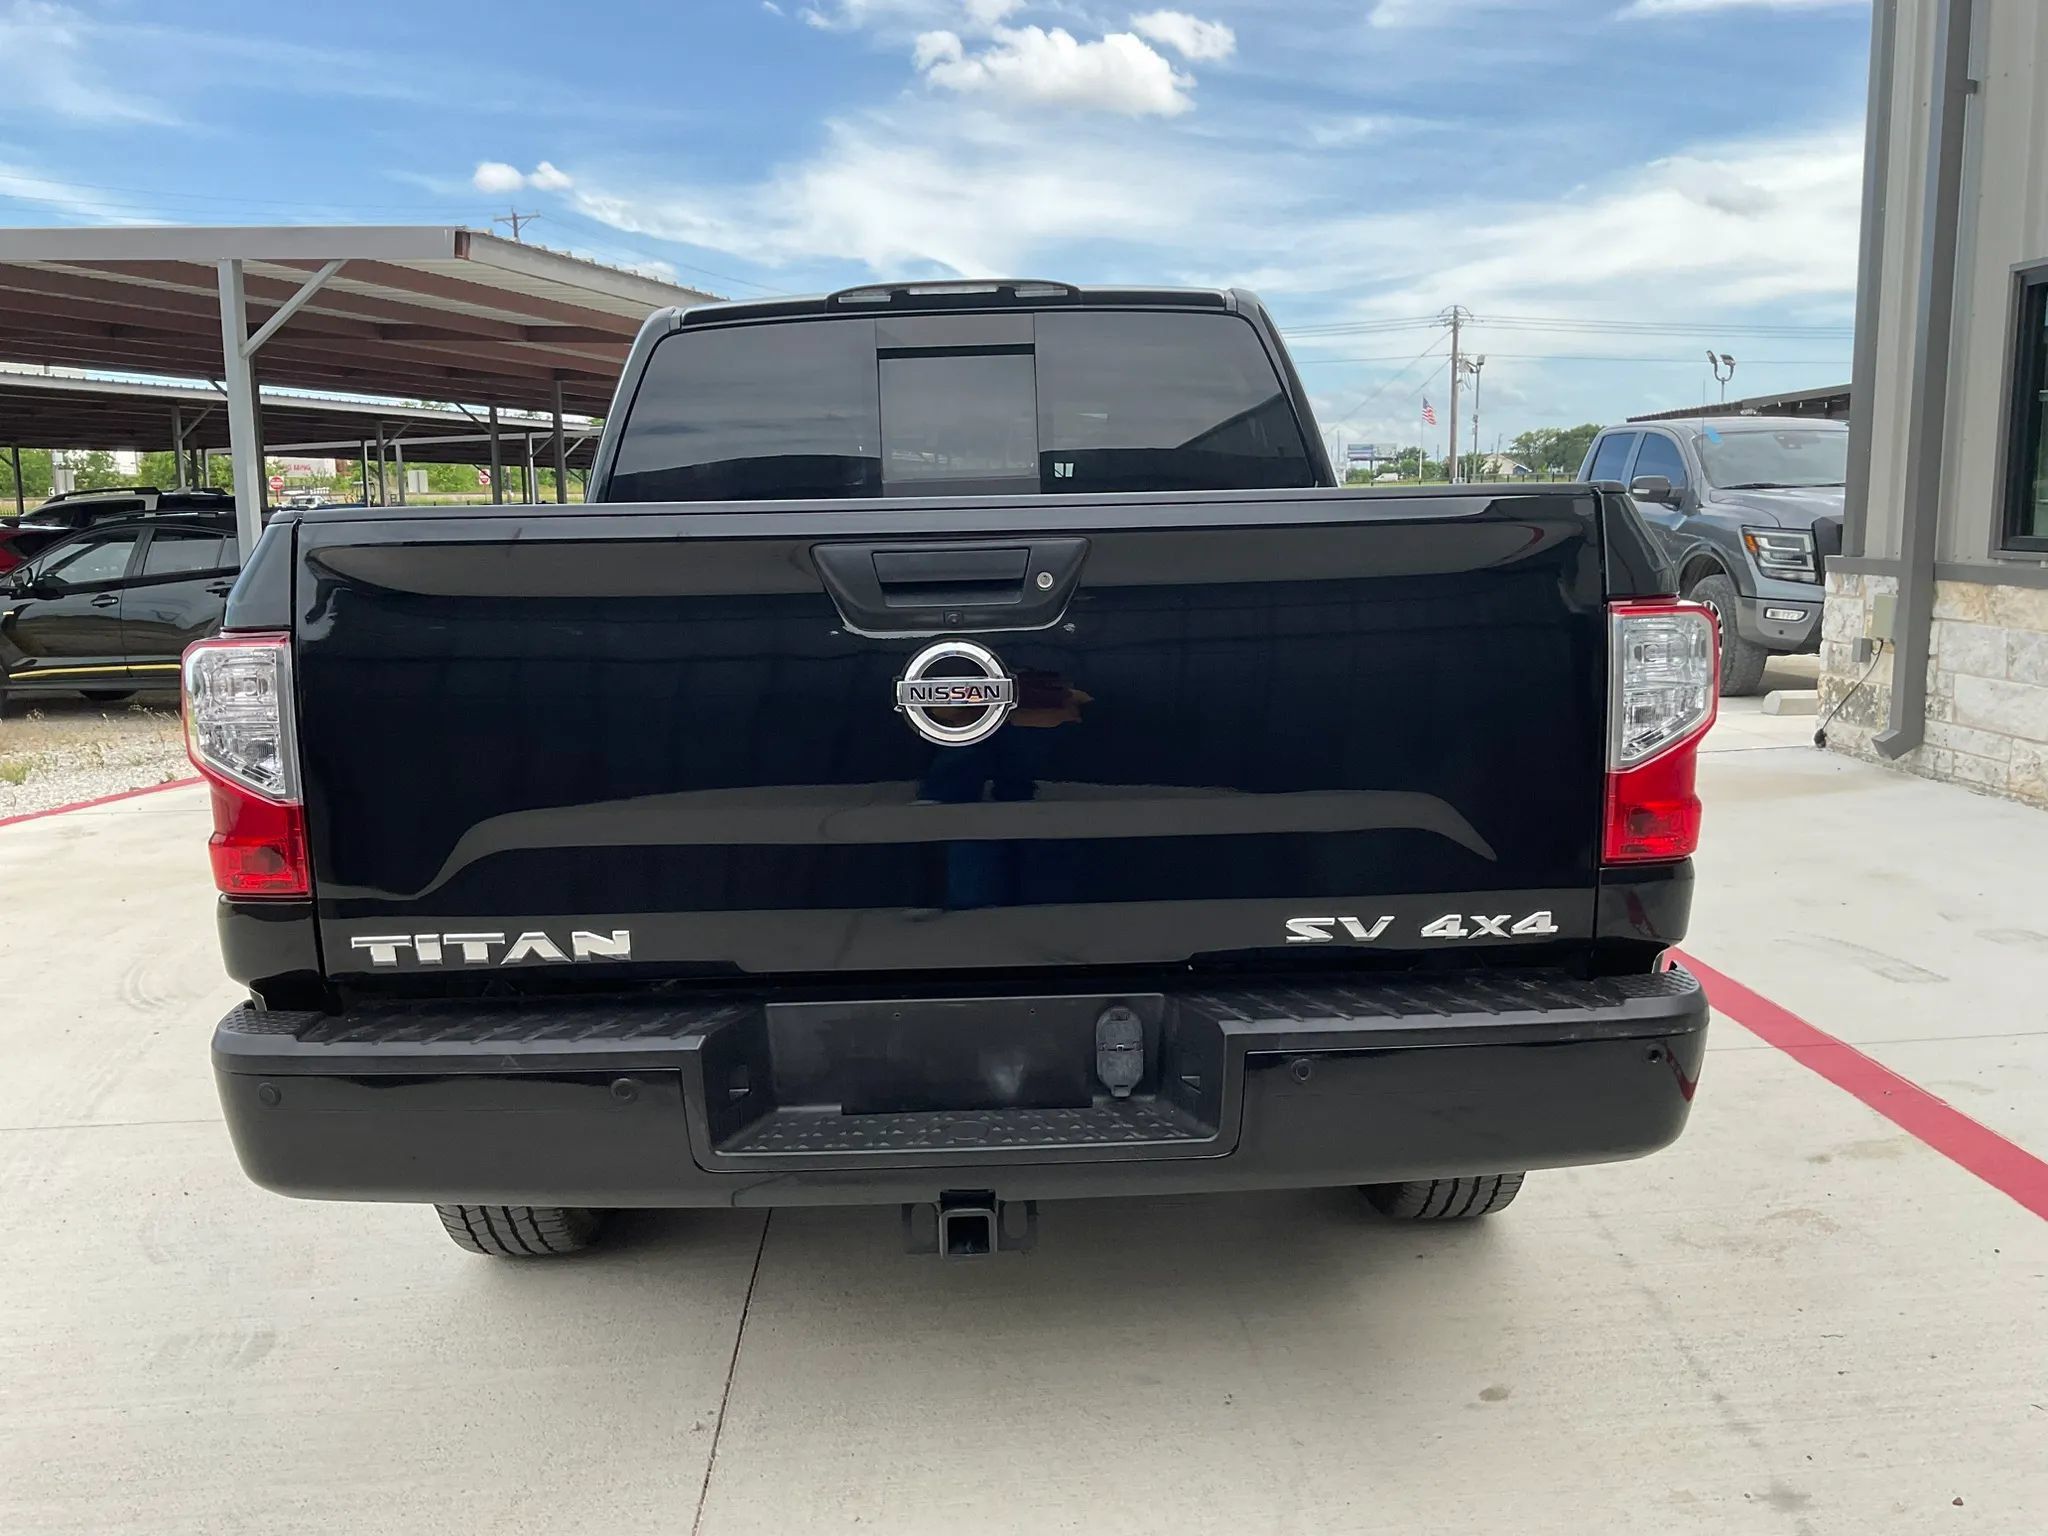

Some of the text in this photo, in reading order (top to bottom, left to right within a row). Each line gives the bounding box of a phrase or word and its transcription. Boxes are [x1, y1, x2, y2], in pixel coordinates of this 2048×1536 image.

[910, 685, 1000, 700] NISSAN
[1285, 915, 1396, 943] SV
[351, 930, 631, 966] TITAN
